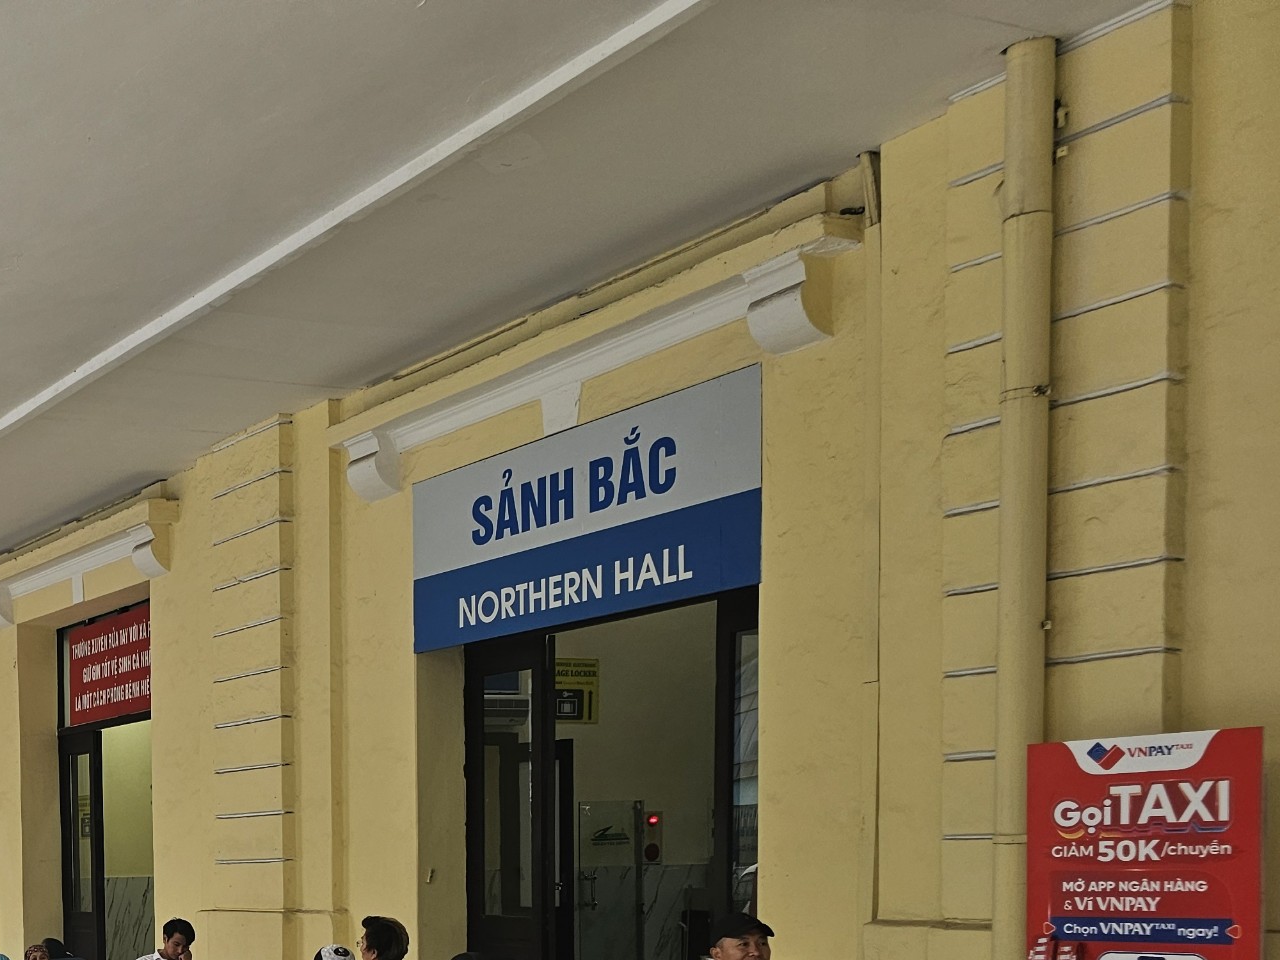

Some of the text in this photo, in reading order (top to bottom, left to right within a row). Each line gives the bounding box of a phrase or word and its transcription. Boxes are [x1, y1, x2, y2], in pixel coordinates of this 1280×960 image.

[471, 425, 677, 546] SẢNH BẮC
[458, 544, 693, 629] NORTHERN HALL
[118, 655, 131, 674] SINH
[570, 669, 597, 677] LOCKER
[93, 687, 106, 707] CÁCH
[125, 679, 140, 702] BỆNH
[140, 674, 151, 698] HIỆ
[1053, 779, 1230, 834] Gọi TAXI
[1051, 843, 1094, 858] GIẢM
[1062, 878, 1208, 892] MỞ APP NGÂN HÀNG
[1063, 900, 1073, 911] &
[1096, 897, 1161, 911] VNPAY
[1063, 923, 1097, 937] Chọn
[1177, 926, 1219, 939] ngay!
